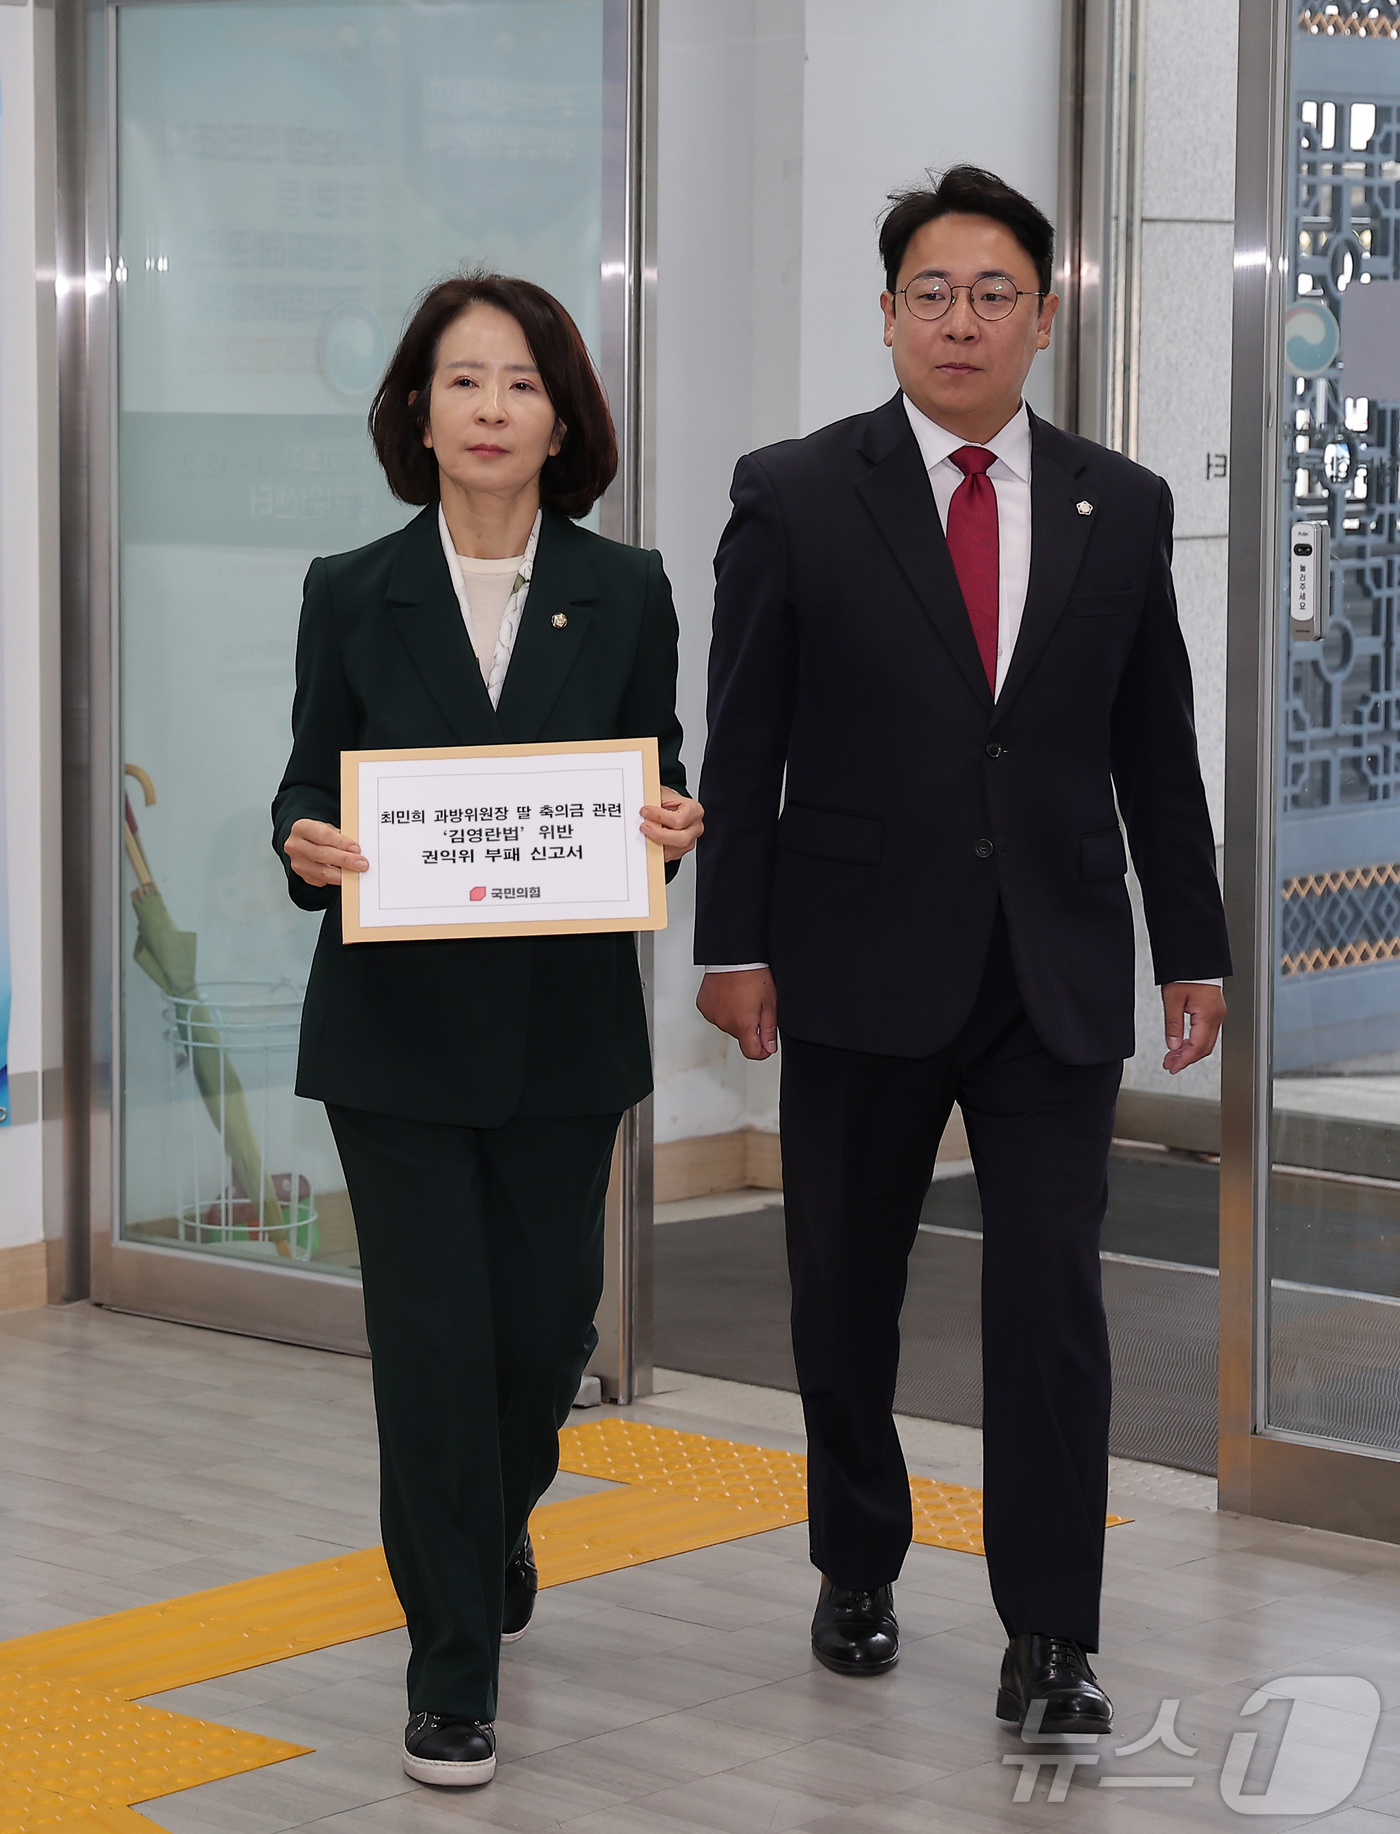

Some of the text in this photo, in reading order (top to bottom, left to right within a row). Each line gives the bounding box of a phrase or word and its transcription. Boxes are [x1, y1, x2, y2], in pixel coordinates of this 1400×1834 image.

[380, 802, 622, 825] 최민희 과방위원장 딸 축의금 관련
[538, 823, 574, 840] 위반
[421, 844, 584, 865] 권익위 부패 신고서
[490, 886, 541, 900] 국민의힘
